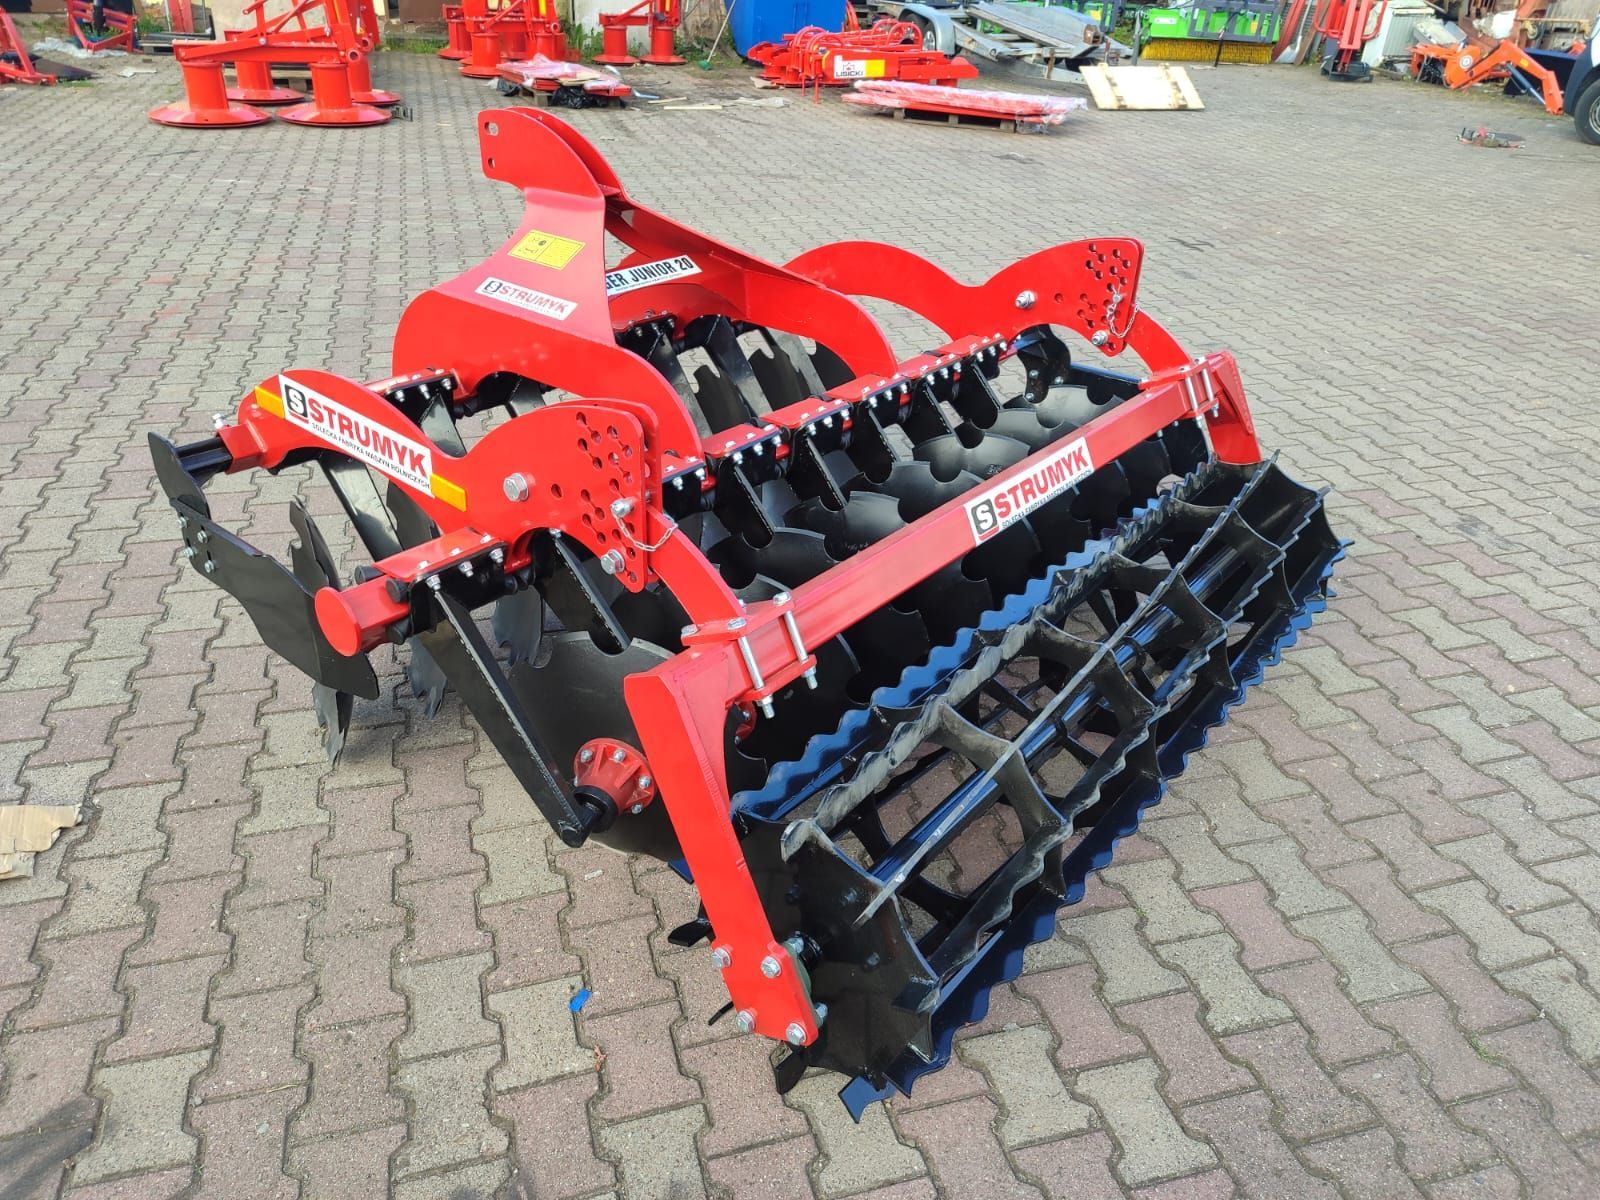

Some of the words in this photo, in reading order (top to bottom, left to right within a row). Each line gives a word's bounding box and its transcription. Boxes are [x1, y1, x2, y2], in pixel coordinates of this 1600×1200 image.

[630, 261, 674, 283] JUNIOR
[675, 257, 693, 271] 20
[499, 285, 569, 313] STRUMYK
[308, 397, 429, 480] STRUMYK
[994, 446, 1089, 519] STRUMYK
